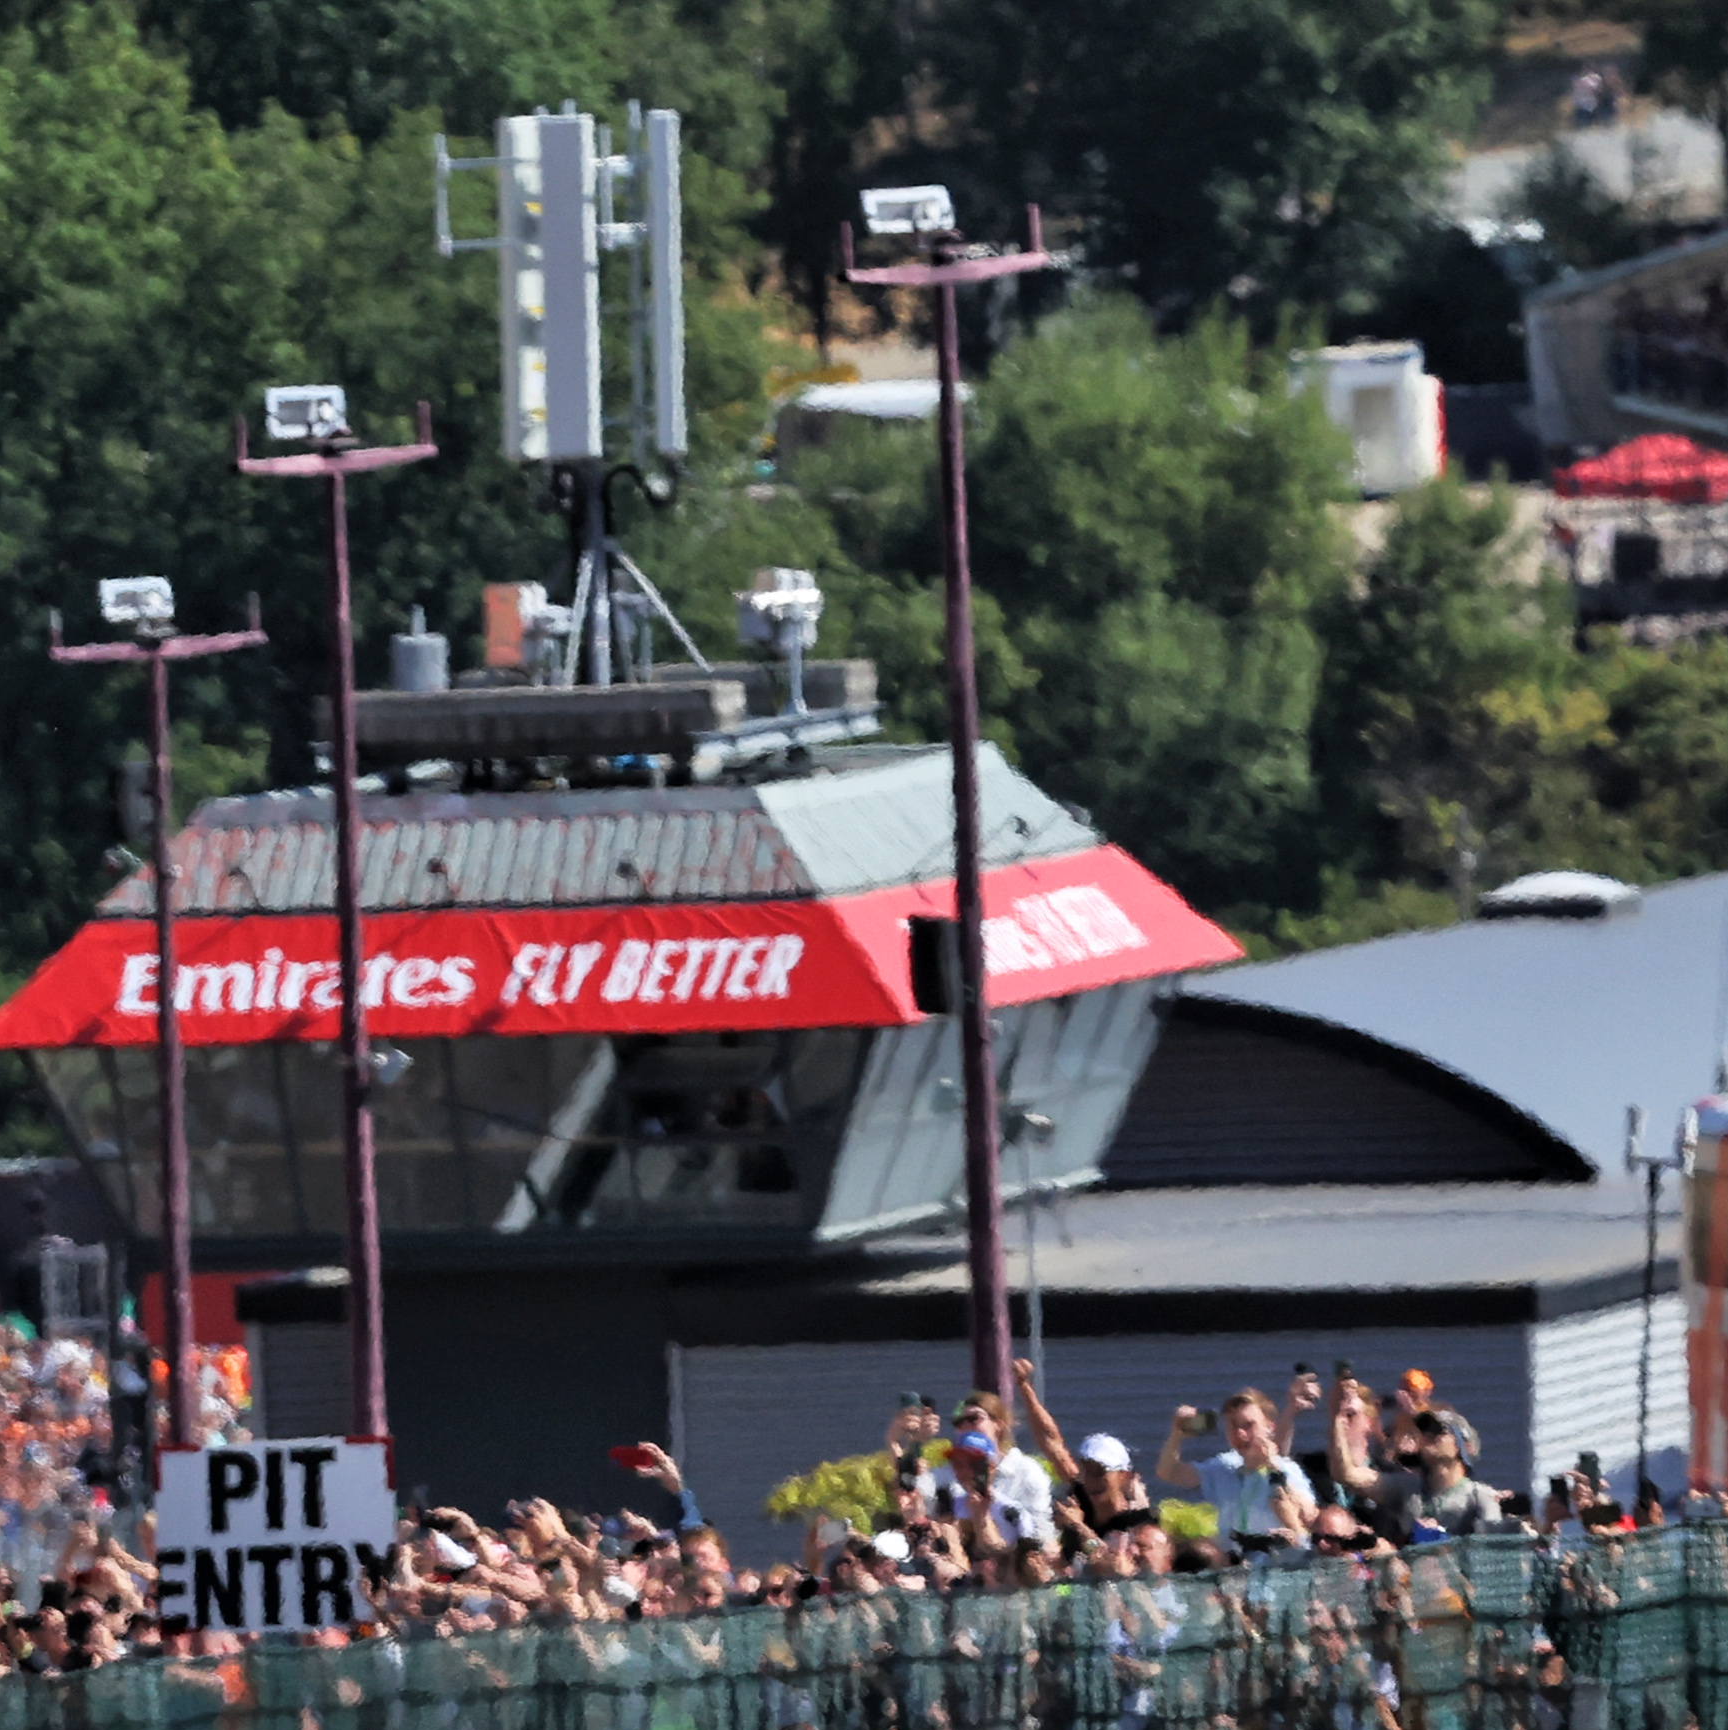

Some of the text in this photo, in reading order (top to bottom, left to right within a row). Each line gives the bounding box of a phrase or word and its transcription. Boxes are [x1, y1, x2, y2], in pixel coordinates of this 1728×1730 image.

[114, 933, 805, 1015] Emirates FLY BETTER
[208, 1447, 336, 1534] PIT
